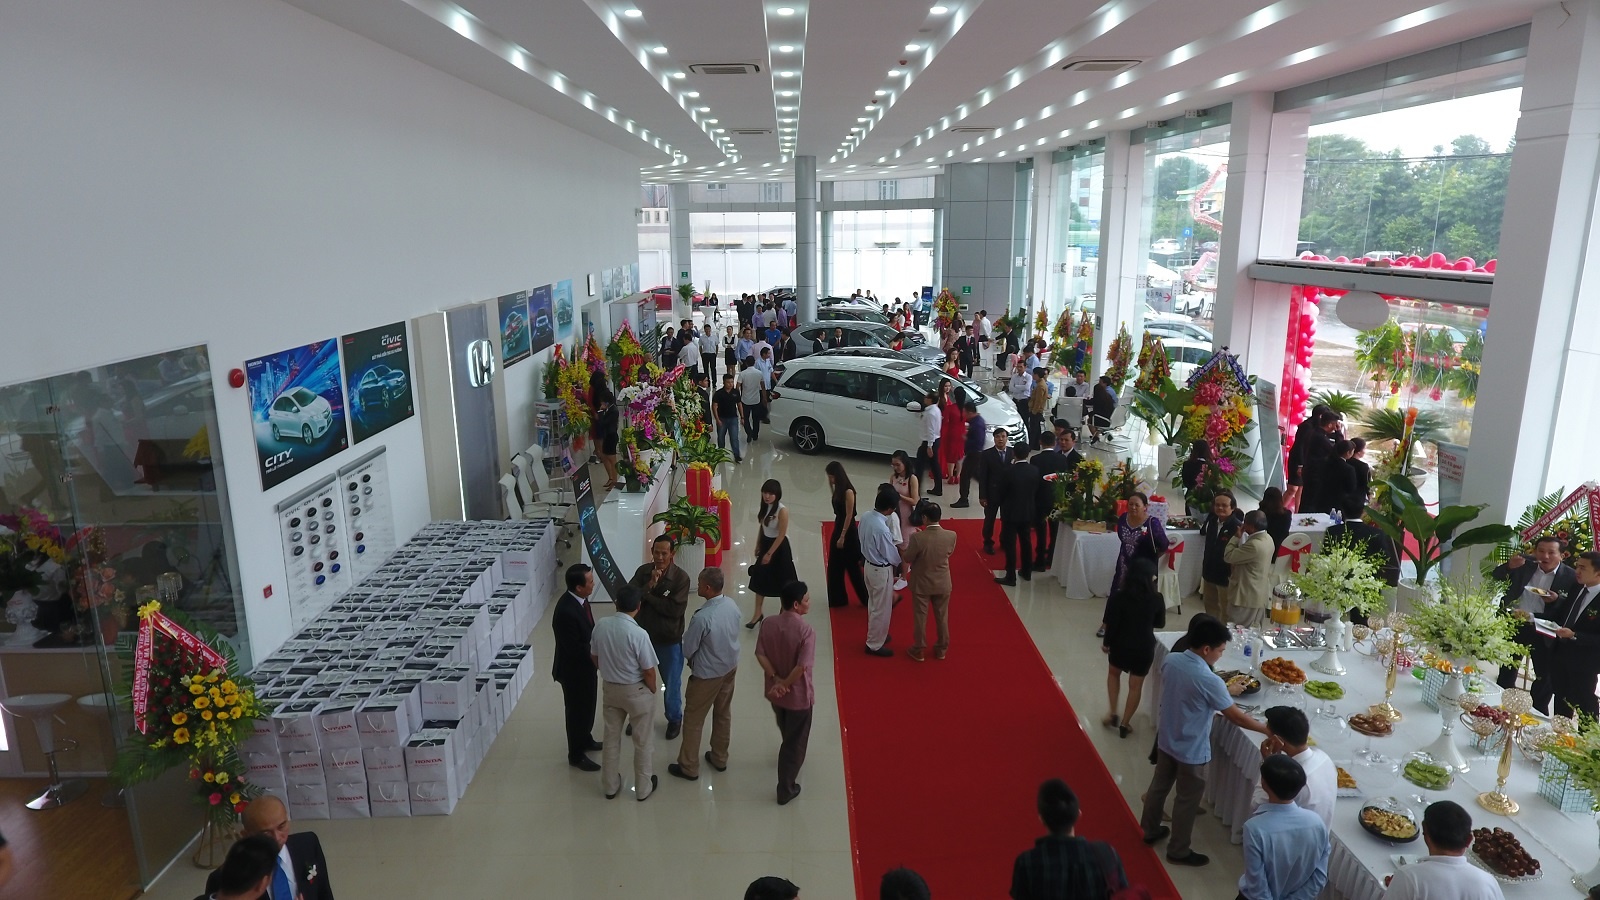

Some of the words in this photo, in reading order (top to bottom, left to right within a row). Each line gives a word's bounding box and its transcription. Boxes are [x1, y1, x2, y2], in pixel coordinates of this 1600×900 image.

[381, 335, 402, 346] CIVIC
[265, 447, 293, 468] CITY
[285, 505, 301, 518] CIVIC
